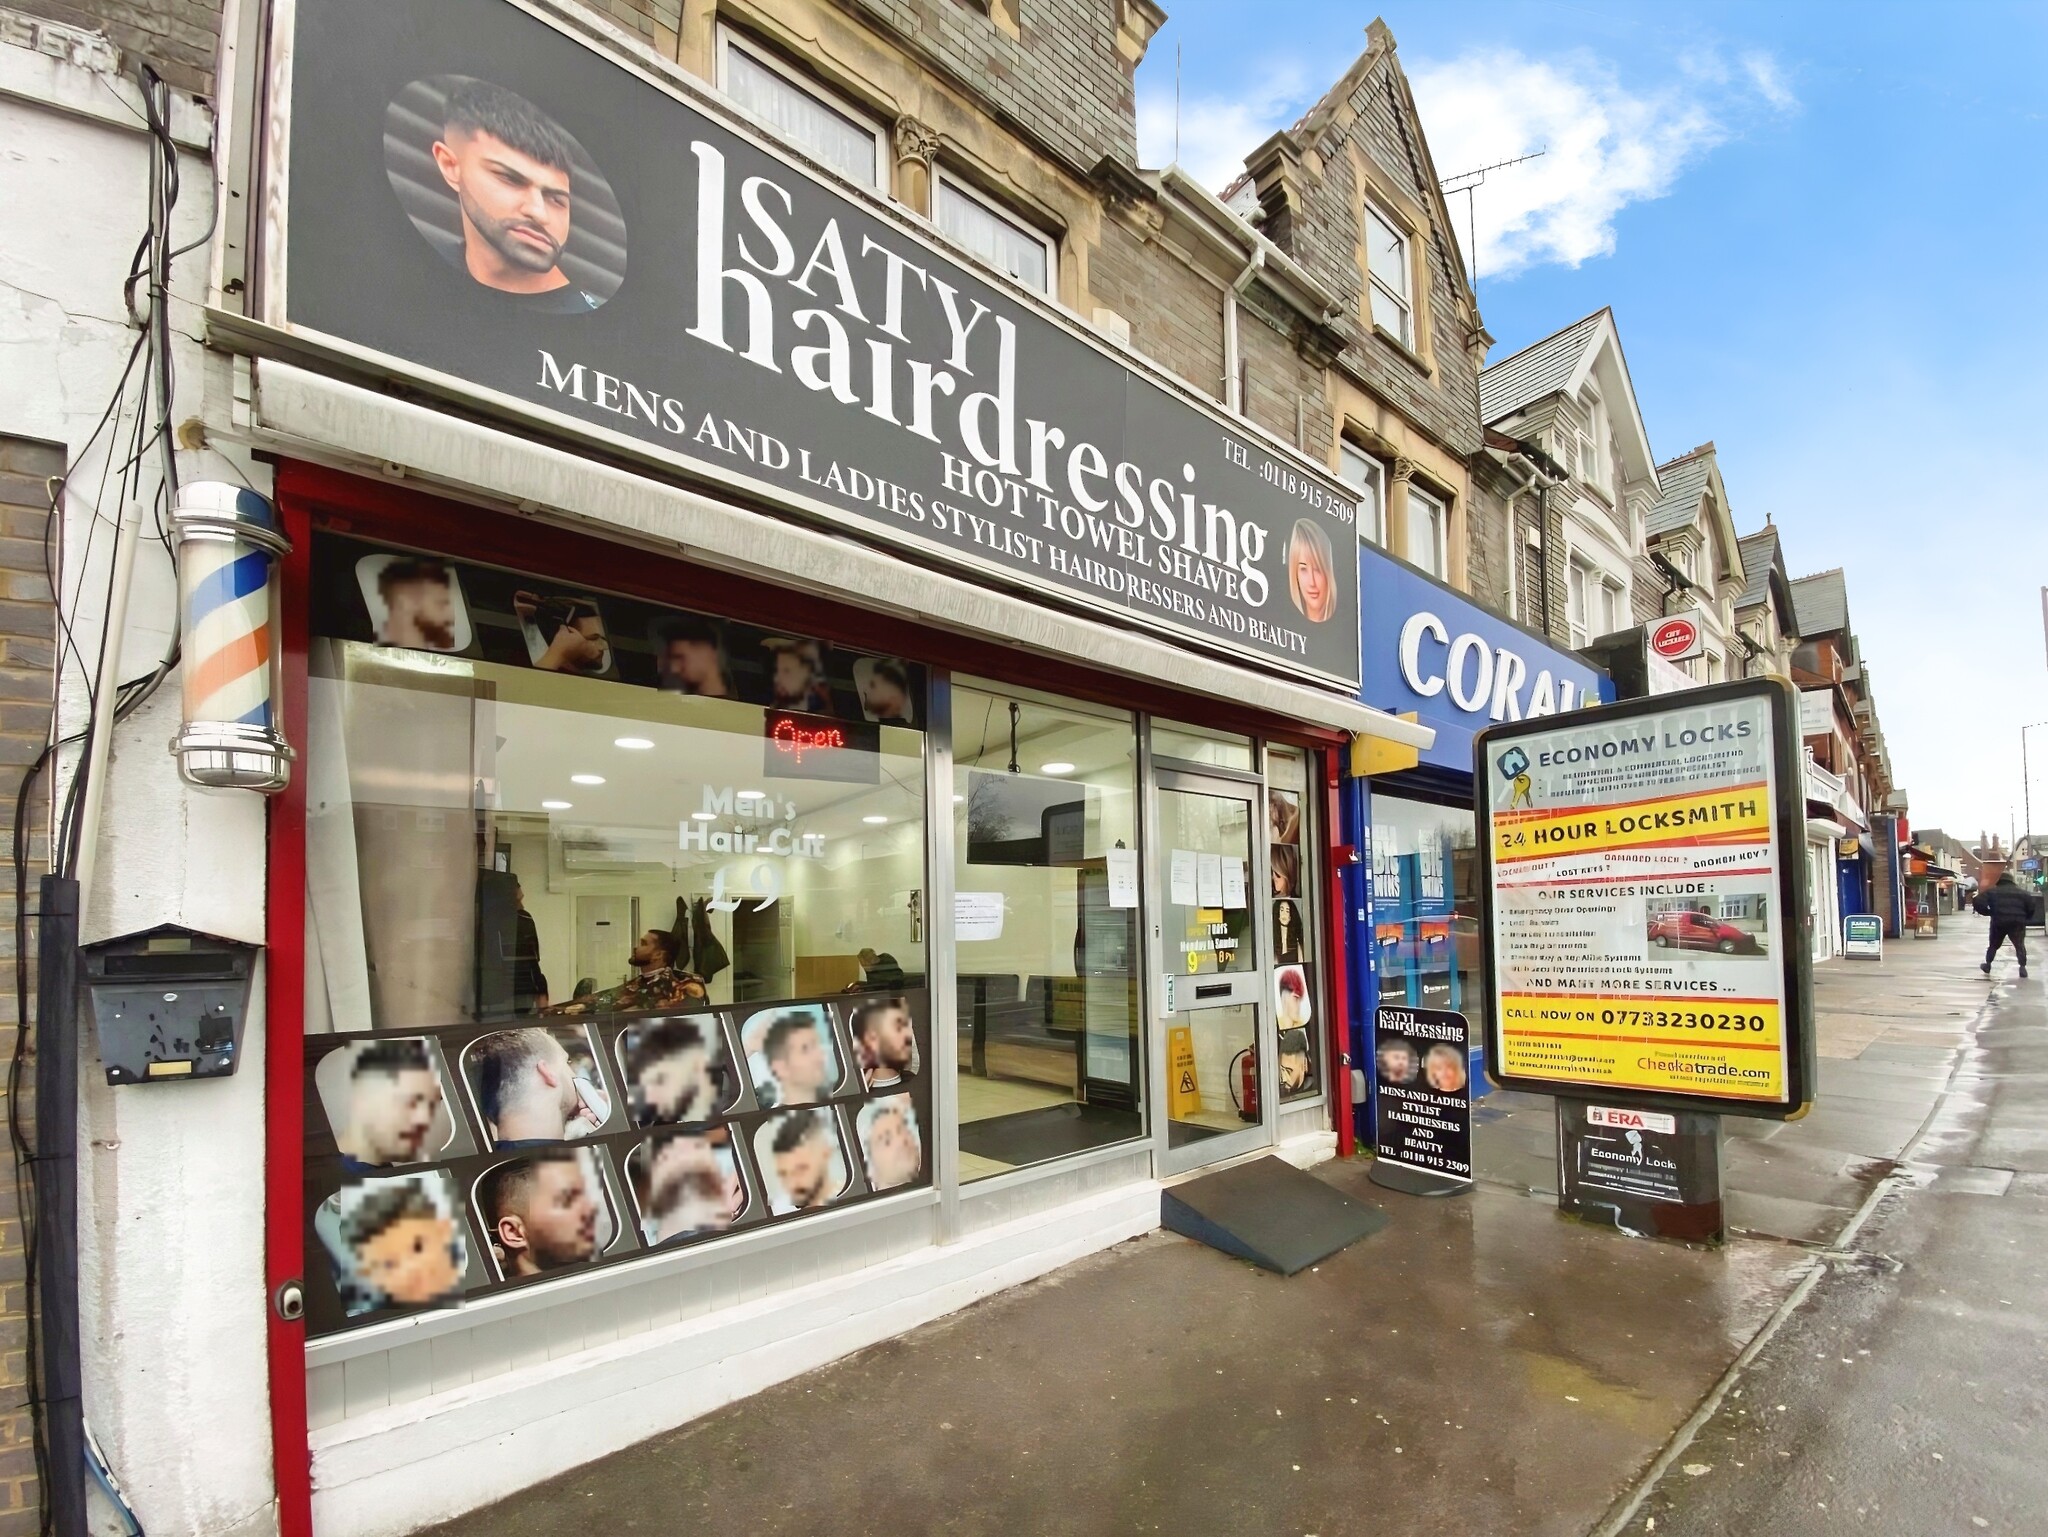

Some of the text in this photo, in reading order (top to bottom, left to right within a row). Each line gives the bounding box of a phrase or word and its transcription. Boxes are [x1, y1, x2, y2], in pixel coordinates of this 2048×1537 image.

[738, 174, 991, 375] SATY
[685, 140, 1269, 608] hairdressing
[1222, 436, 1251, 471] TEL
[1300, 480, 1322, 509] 915
[1325, 495, 1354, 525] 2509
[536, 349, 1308, 655] MENS AND LADIES STYLIST HAIRDRESSERS AND BEAUTY
[940, 451, 1239, 600] HOT TOWEL SHAVE
[774, 719, 844, 763] Open
[1539, 720, 1752, 767] ECONOMY LOCKS
[702, 784, 796, 821] Men's
[679, 821, 758, 854] Hair
[1501, 800, 1756, 847] 24 HOUR LOCKSMITH
[1569, 887, 1635, 899] SERVICES
[1640, 883, 1706, 896] INCLUDE
[1527, 978, 1552, 988] AND
[1600, 979, 1641, 990] MORE
[1645, 980, 1718, 992] SERVICES
[1379, 1010, 1464, 1042] hairdressing
[1382, 1010, 1410, 1022] SATY
[1506, 1008, 1765, 1032] CALL NOW ON 07733230230
[1379, 1085, 1467, 1109] MENS AND LADIES
[1402, 1102, 1441, 1116] STYLIST
[1388, 1110, 1460, 1132] HAIRDRESSERS
[1412, 1127, 1434, 1139] AND
[1607, 1111, 1645, 1128] ERA
[1380, 1144, 1396, 1156] TEL
[1427, 1156, 1444, 1167] 915
[1446, 1160, 1469, 1173] 2509
[1404, 1137, 1443, 1153] BEAUTY
[1591, 1147, 1643, 1166] Economy
